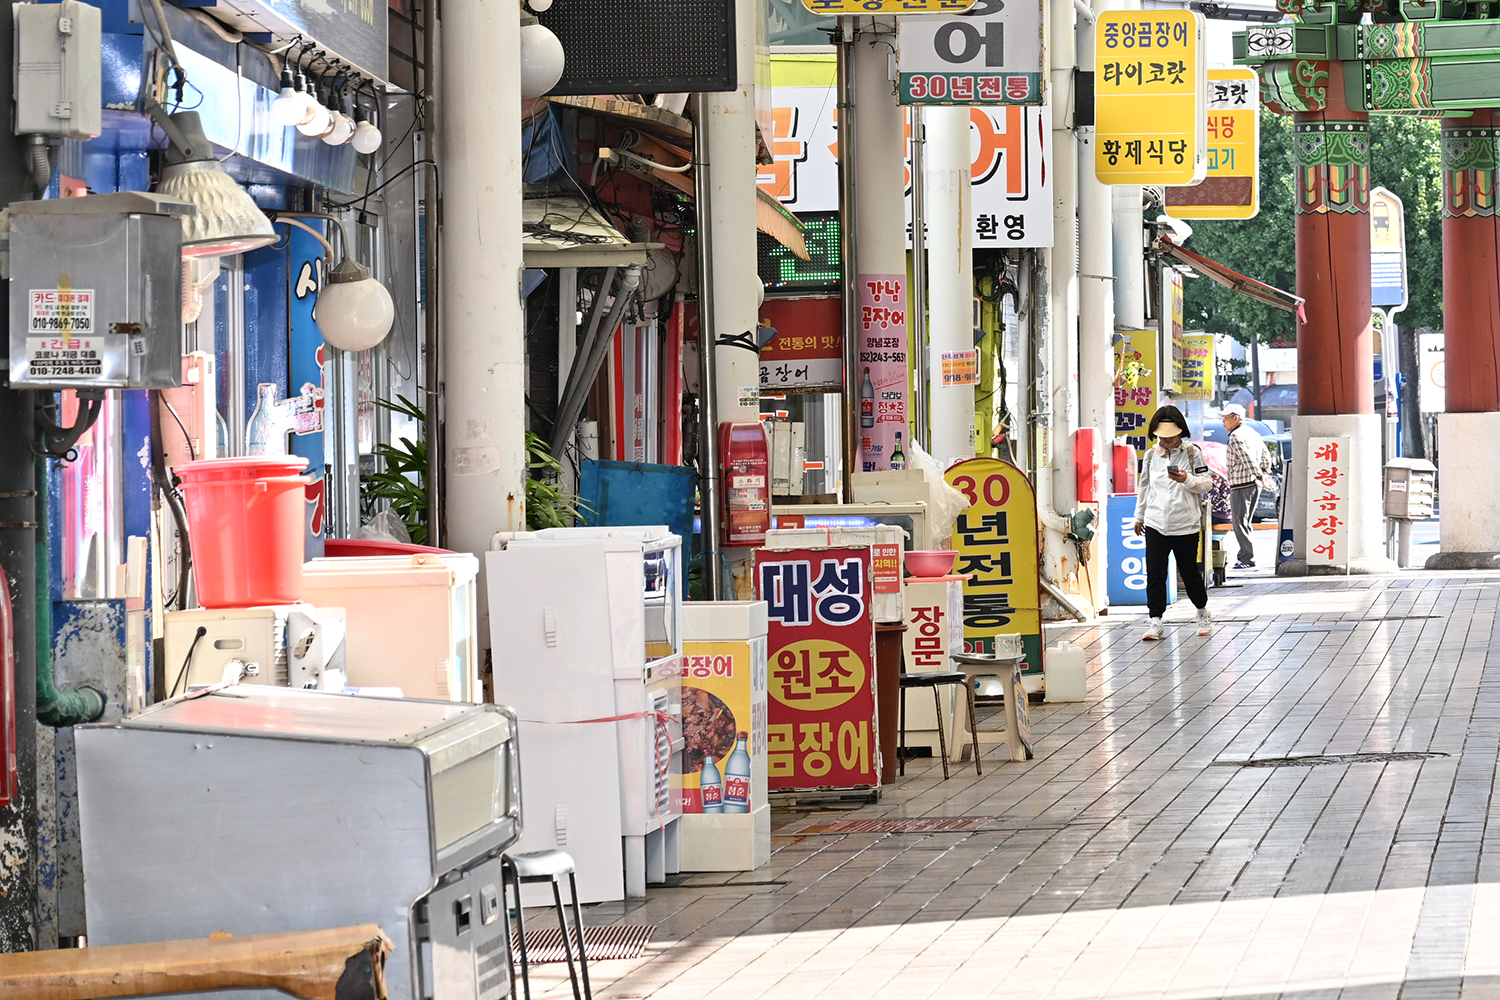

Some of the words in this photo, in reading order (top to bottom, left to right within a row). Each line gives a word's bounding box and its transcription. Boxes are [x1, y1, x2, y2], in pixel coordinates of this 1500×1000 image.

[1104, 22, 1188, 48] 중앙곰장어
[910, 74, 1030, 100] 30년전통
[1102, 139, 1188, 166] 황제식당
[35, 293, 54, 303] 카드
[867, 281, 901, 303] 강남
[33, 317, 90, 329] 010-9869-7050
[860, 305, 905, 332] 곰장어
[779, 336, 817, 350] 전통의
[866, 337, 900, 349] 양념포장
[35, 350, 59, 358] 코로나
[30, 367, 101, 375] 010-7248-4410
[760, 363, 808, 384] 곰장어
[882, 548, 897, 557] 인한
[761, 560, 863, 626] 대성
[773, 650, 857, 700] 원조
[768, 720, 869, 779] 곰장어
